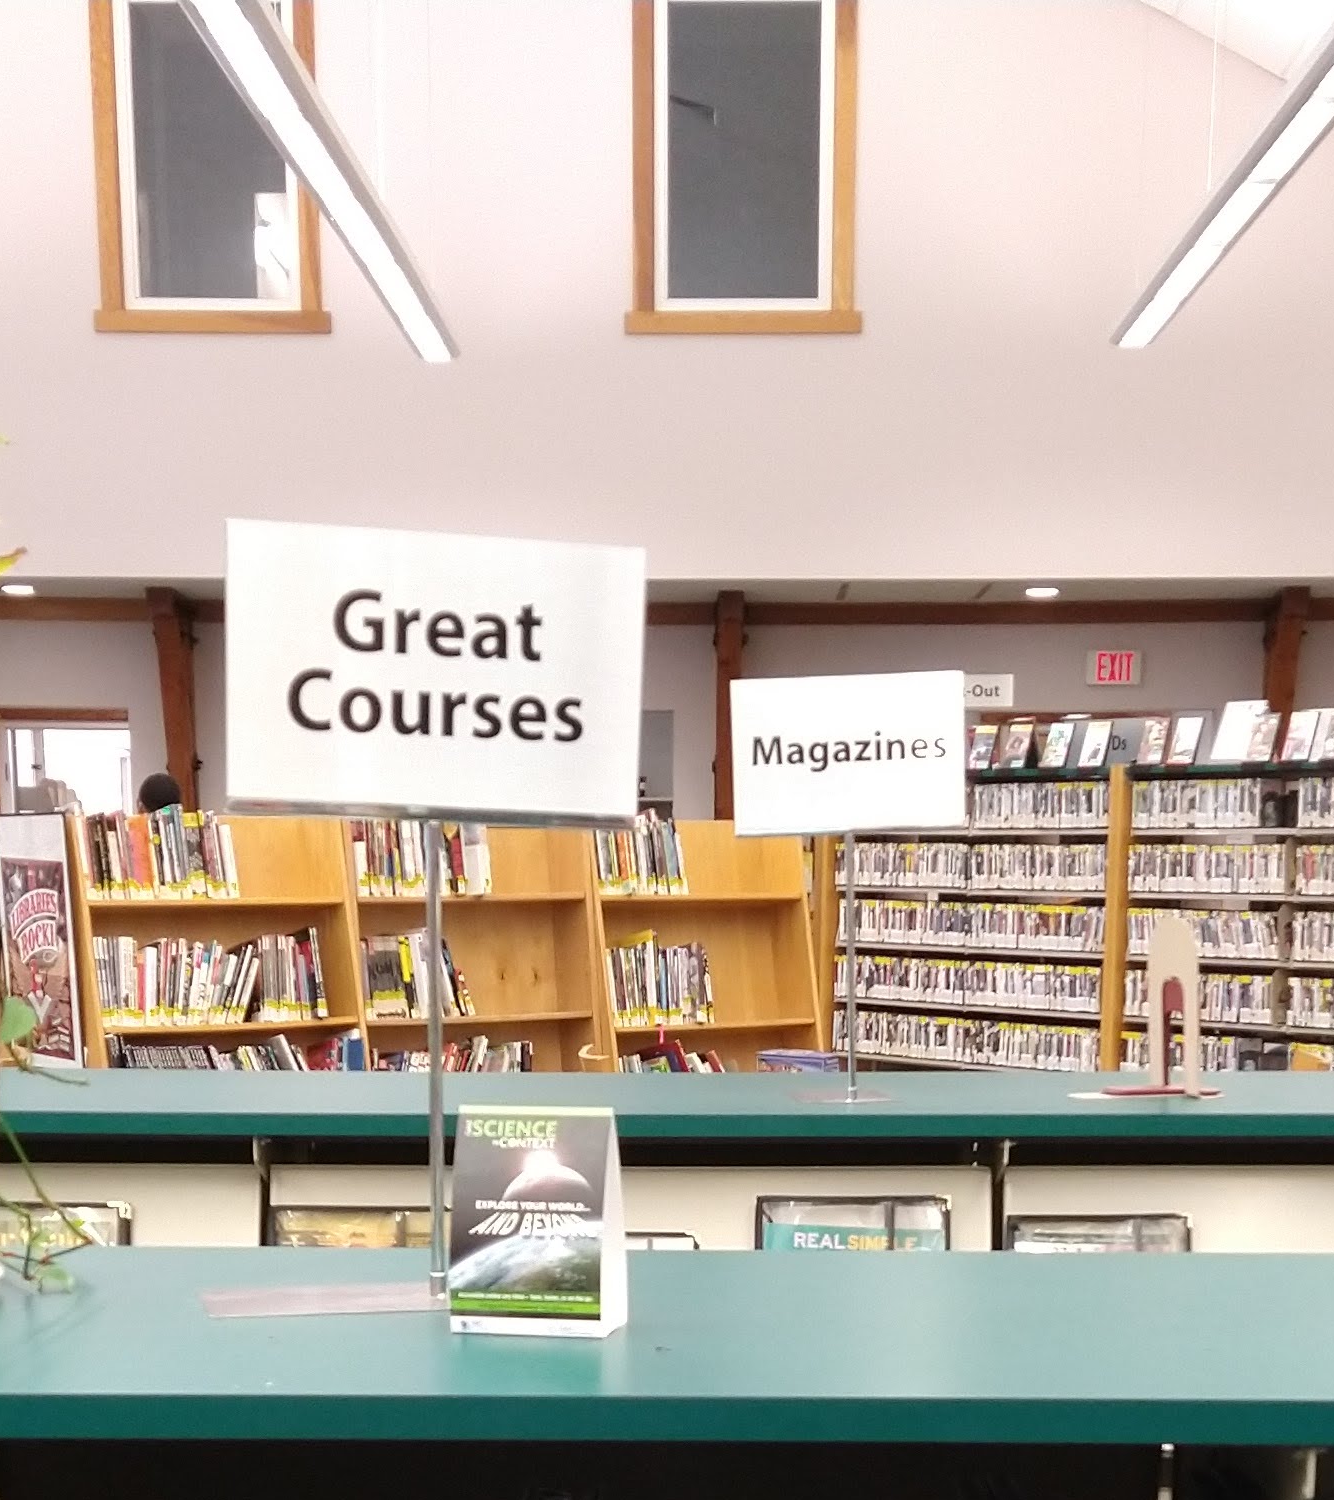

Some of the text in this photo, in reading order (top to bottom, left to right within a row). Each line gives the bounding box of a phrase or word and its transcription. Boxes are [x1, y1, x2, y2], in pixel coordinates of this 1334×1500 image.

[332, 587, 542, 662] Great
[1097, 652, 1134, 682] EXIT
[963, 684, 1000, 697] -Out
[287, 666, 583, 742] Courses
[752, 731, 947, 772] Magazines
[11, 890, 57, 934] LIBRARIES
[473, 1119, 557, 1138] SCIENCE
[500, 1138, 556, 1149] CONTEXT
[475, 1199, 518, 1210] EXPLORE
[520, 1201, 547, 1211] YOUR
[469, 1212, 520, 1236] AND
[794, 1232, 846, 1249] REAL
